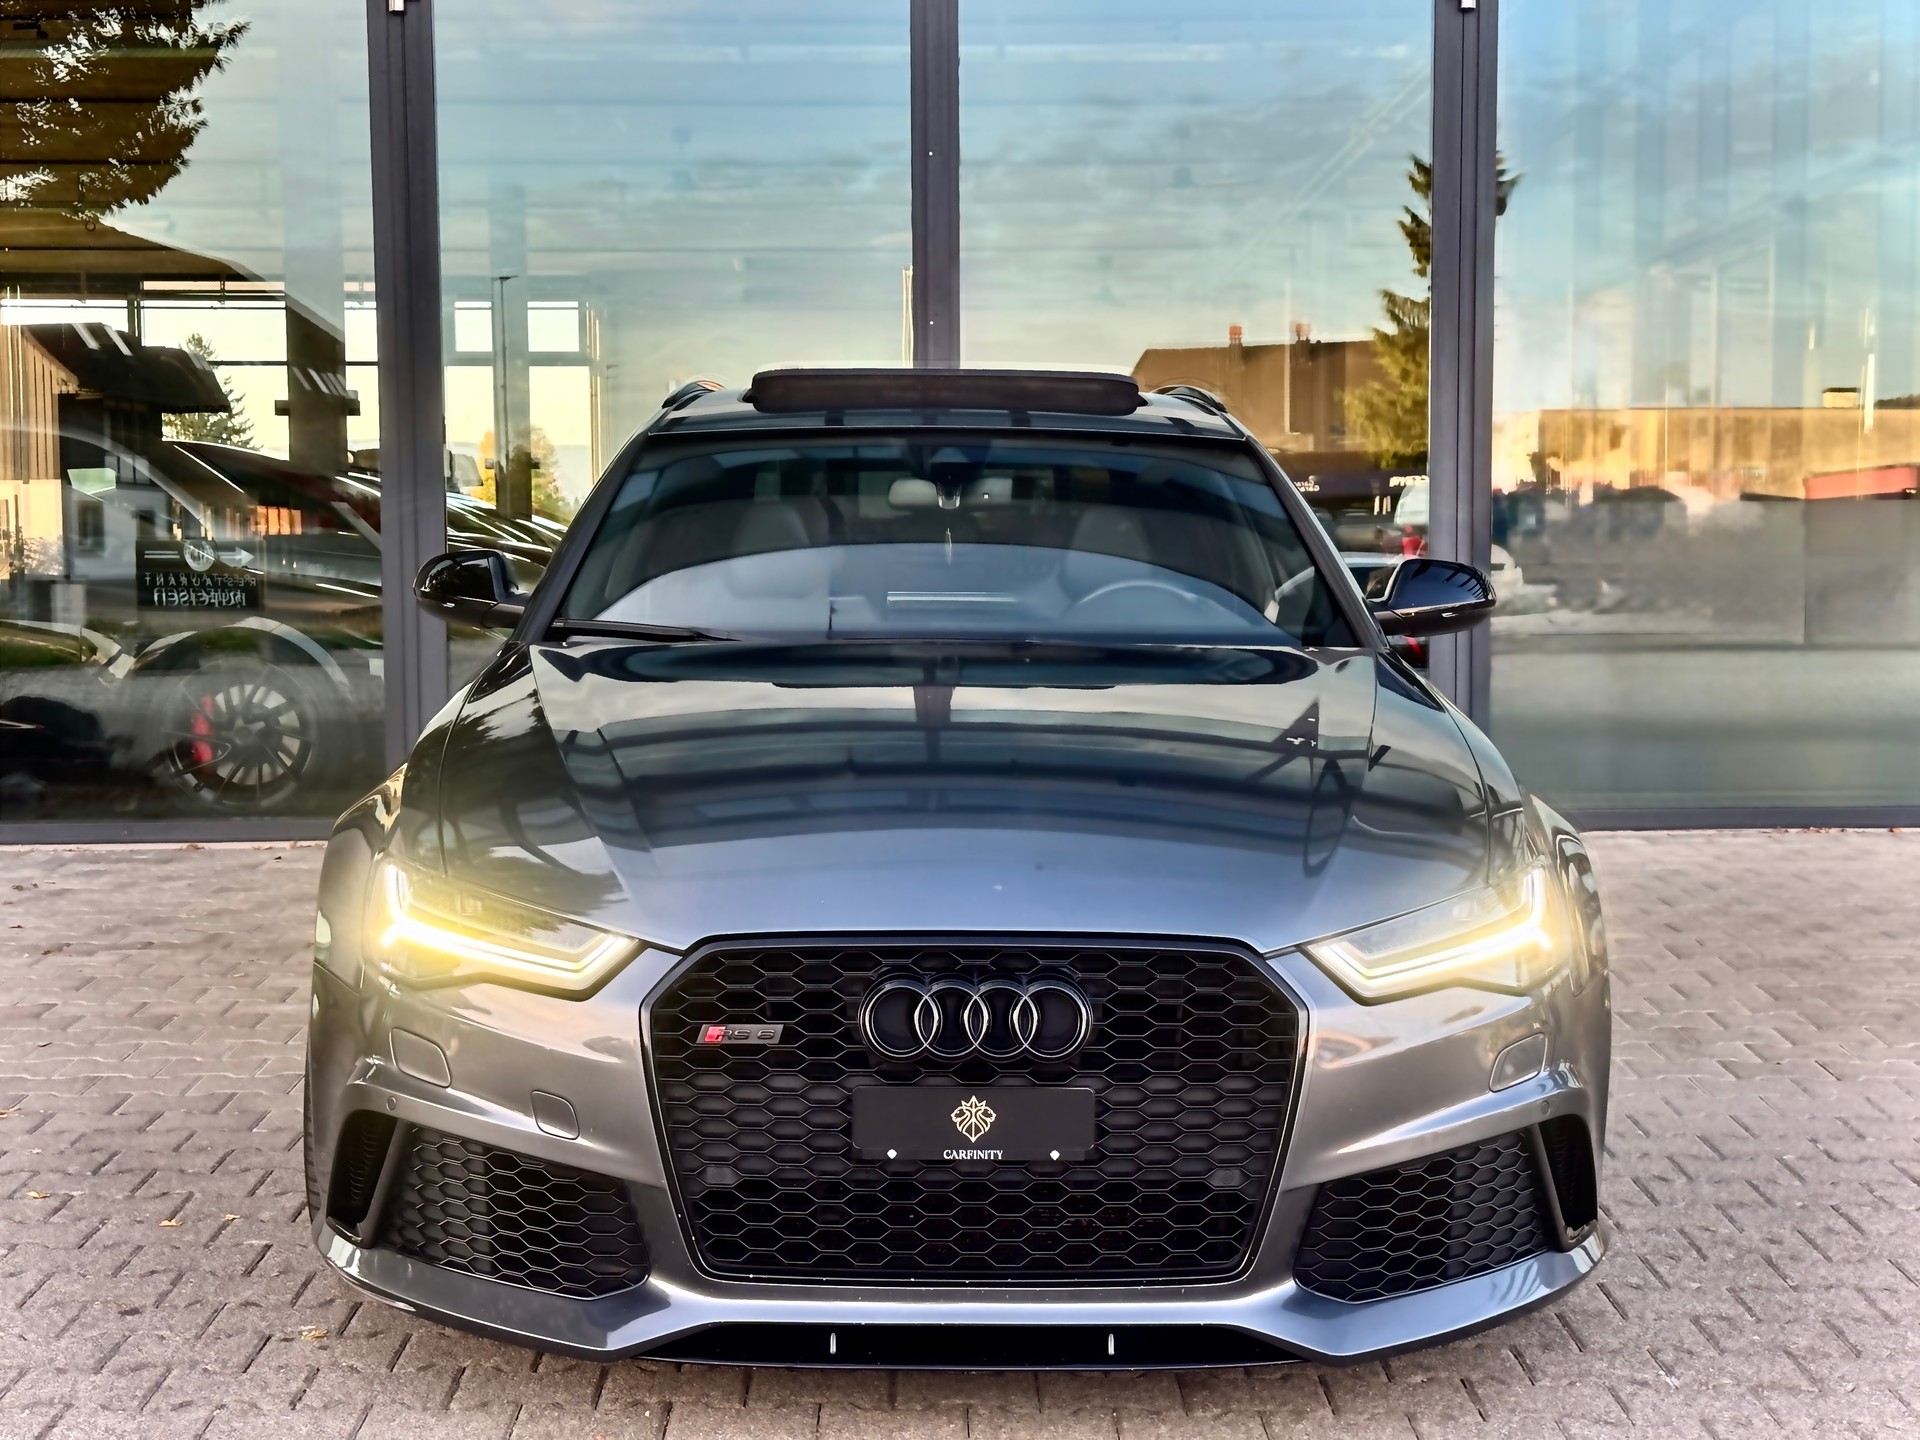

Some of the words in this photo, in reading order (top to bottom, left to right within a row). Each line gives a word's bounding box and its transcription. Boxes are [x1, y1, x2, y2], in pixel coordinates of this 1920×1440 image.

[715, 1029, 751, 1040] RS
[757, 1029, 776, 1040] 6
[943, 1149, 1003, 1160] CARFINITY
